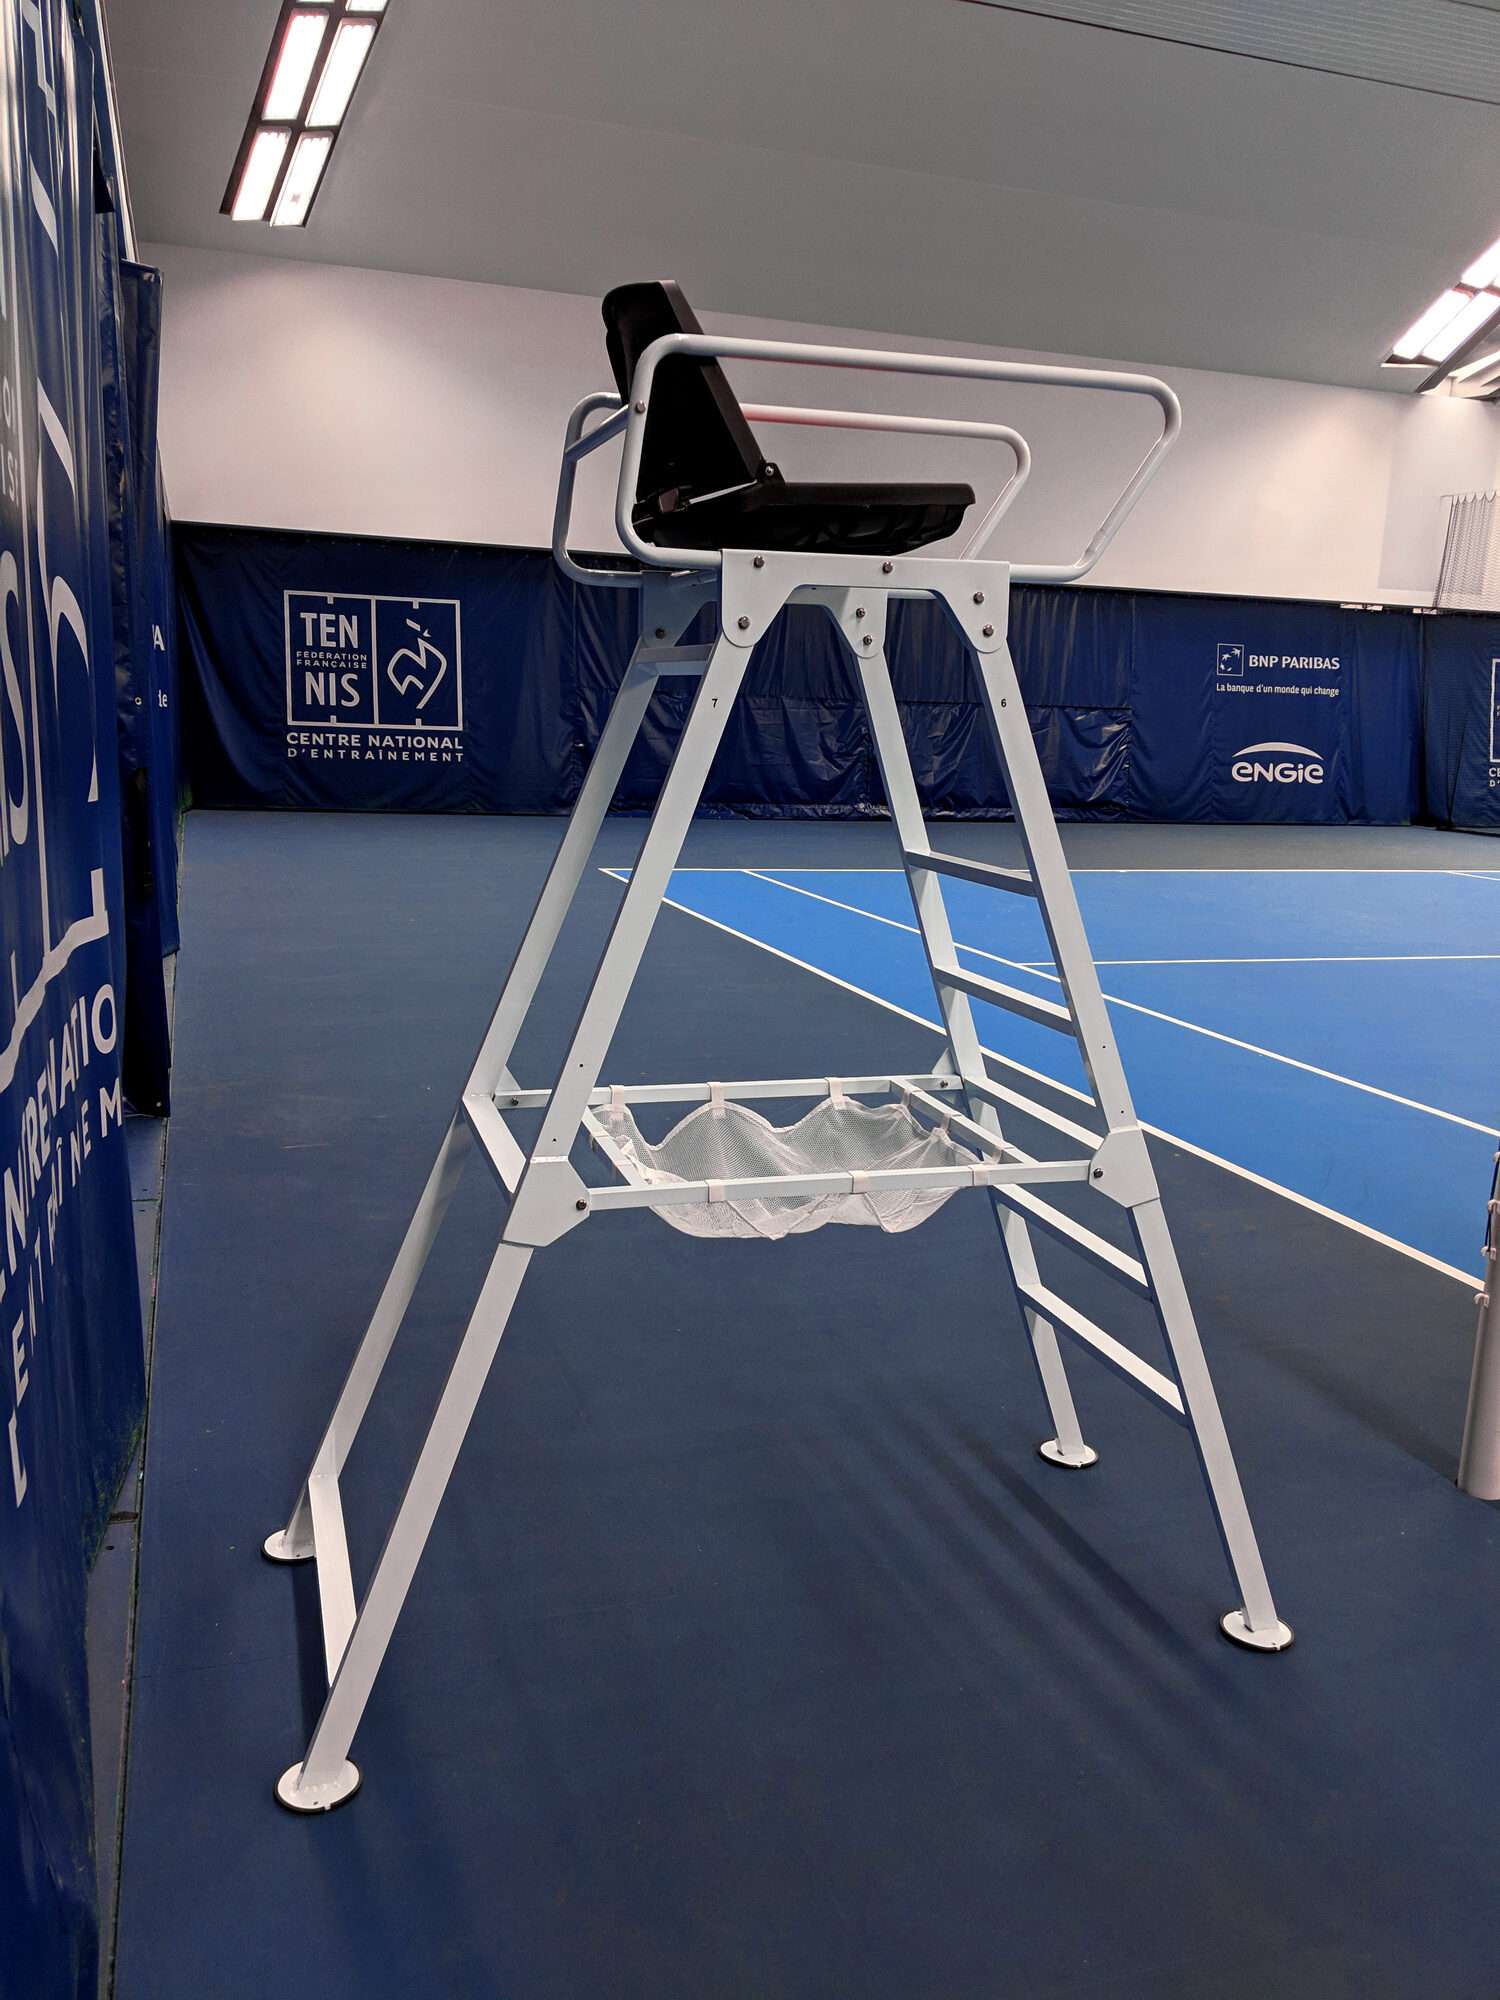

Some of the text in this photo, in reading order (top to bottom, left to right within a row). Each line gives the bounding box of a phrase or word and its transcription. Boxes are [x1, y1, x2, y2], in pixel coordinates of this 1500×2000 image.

[300, 612, 359, 648] TEN
[1249, 655, 1341, 670] BNP PARIBAS
[305, 671, 360, 707] NIS
[1216, 683, 1340, 697] La banque d'un monde qui change
[712, 698, 718, 708] 7
[1001, 698, 1007, 708] 6
[286, 732, 464, 750] CENTRE NATIONAL
